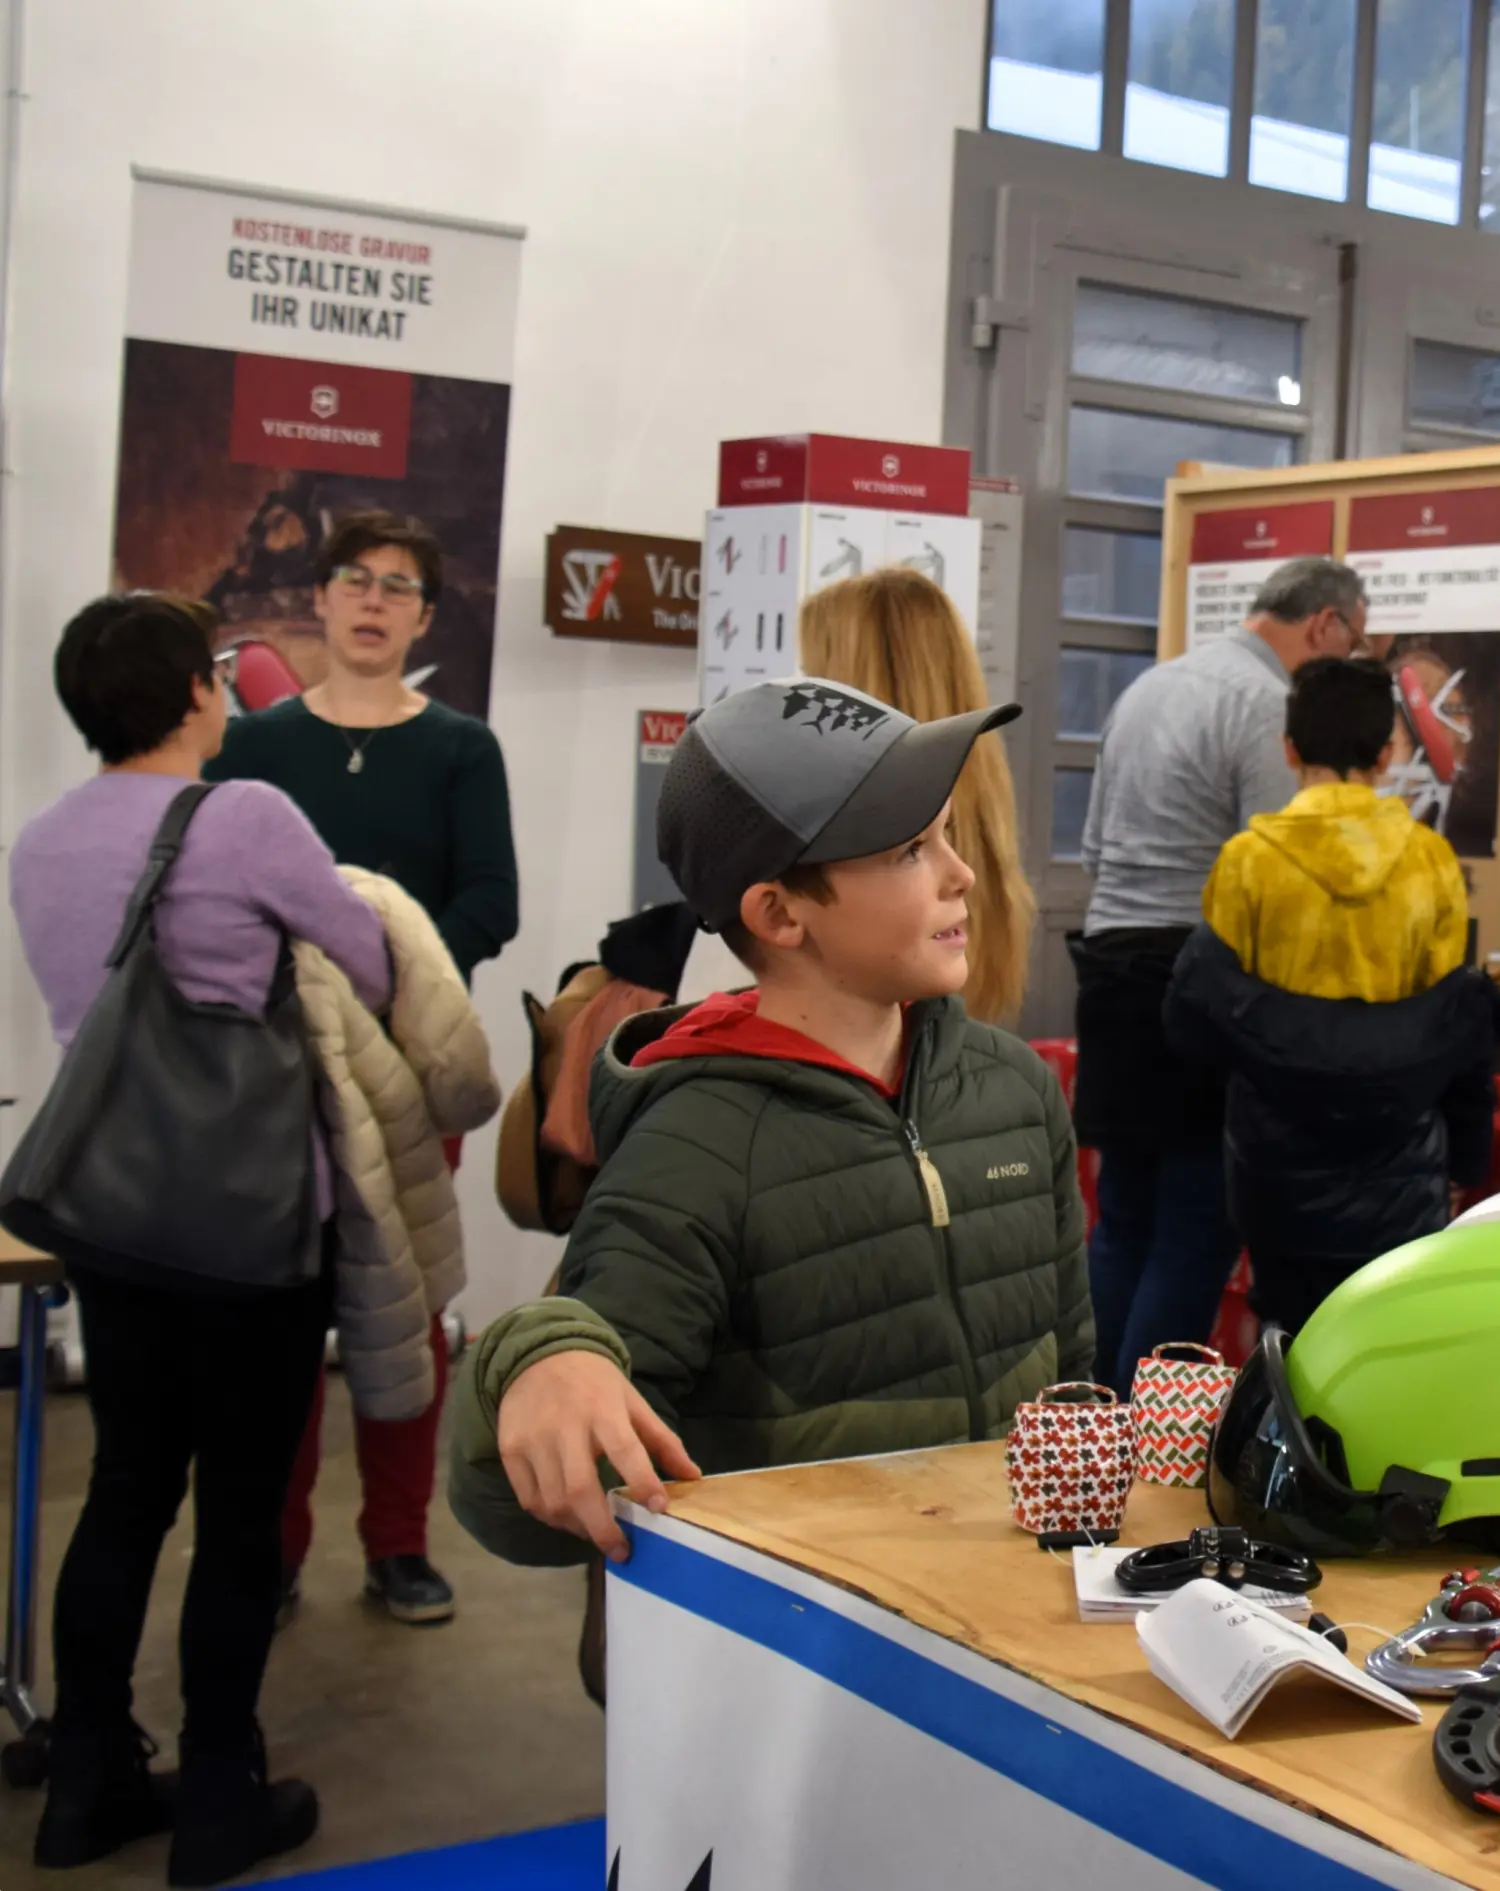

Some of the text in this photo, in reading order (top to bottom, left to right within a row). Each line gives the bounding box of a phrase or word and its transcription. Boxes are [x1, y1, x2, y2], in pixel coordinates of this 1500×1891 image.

[232, 217, 431, 265] KOSTENLOSE GRAVUR
[227, 248, 433, 306] GESTALTEN SIE
[251, 292, 407, 342] IHR UNIKAT
[260, 418, 382, 448] VICTORINOX
